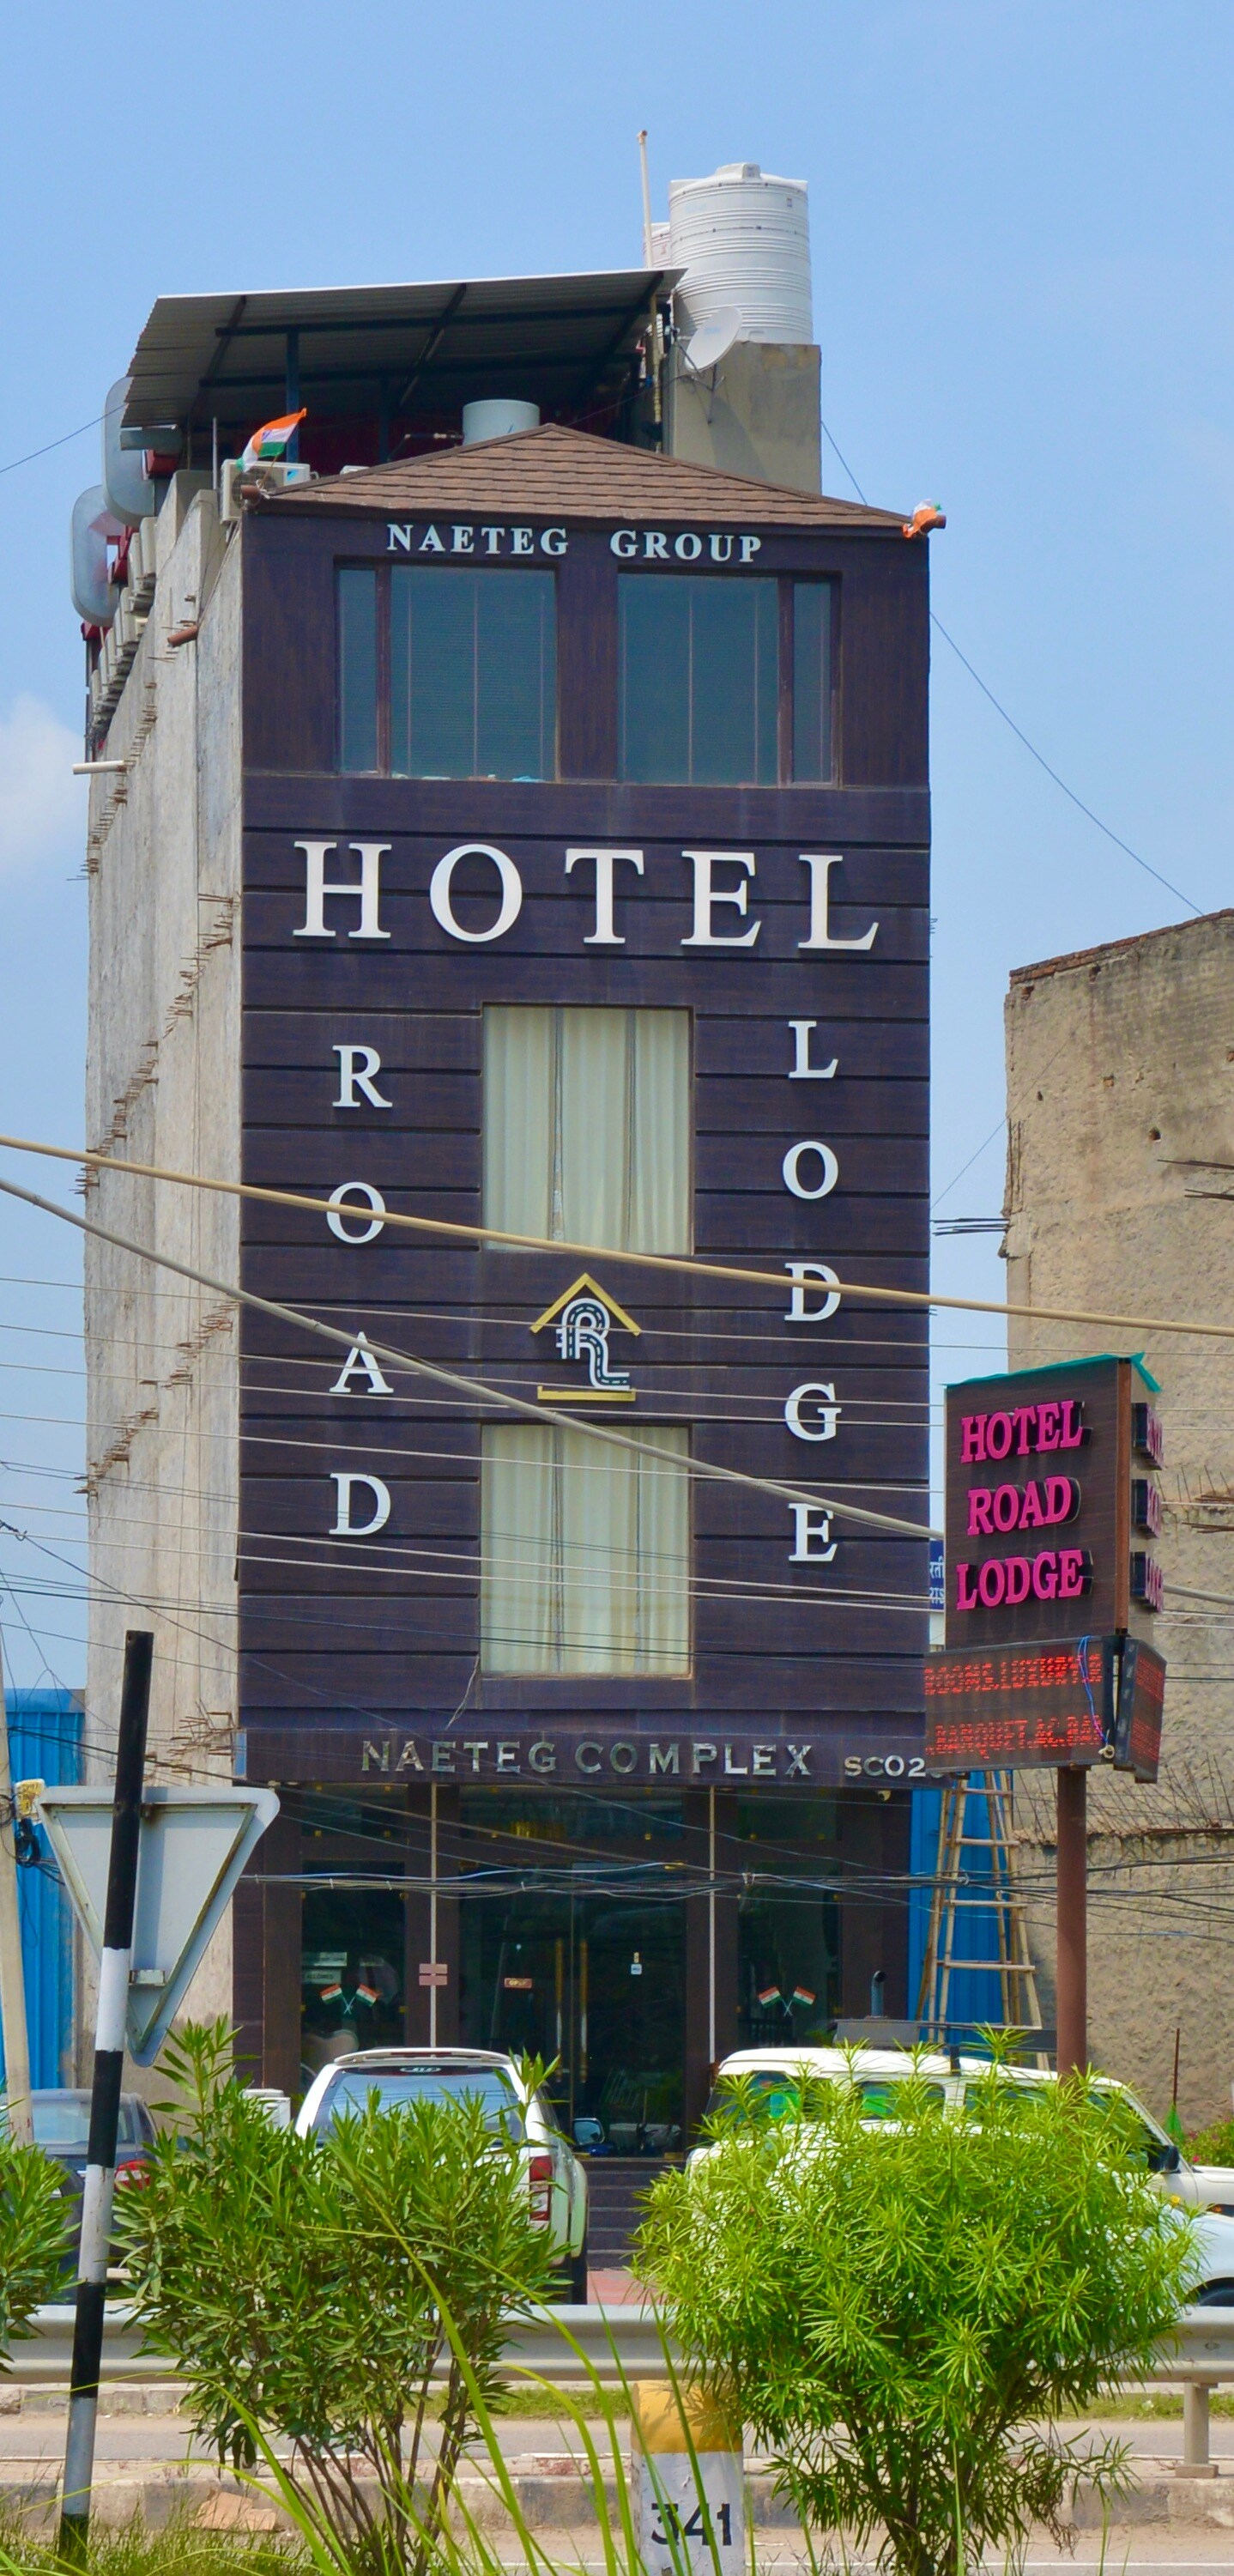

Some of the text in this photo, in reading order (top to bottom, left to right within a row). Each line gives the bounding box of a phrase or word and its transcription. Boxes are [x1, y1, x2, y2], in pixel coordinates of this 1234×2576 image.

[387, 524, 762, 563] NAETEG GROUP
[293, 840, 880, 950] HOTEL
[960, 1399, 1085, 1464] HOTEL
[967, 1475, 1073, 1537] ROAD
[956, 1549, 1085, 1611] LODGE
[361, 1740, 944, 1779] NAETEG COMPLEX SCO2
[650, 2502, 732, 2547] 341
